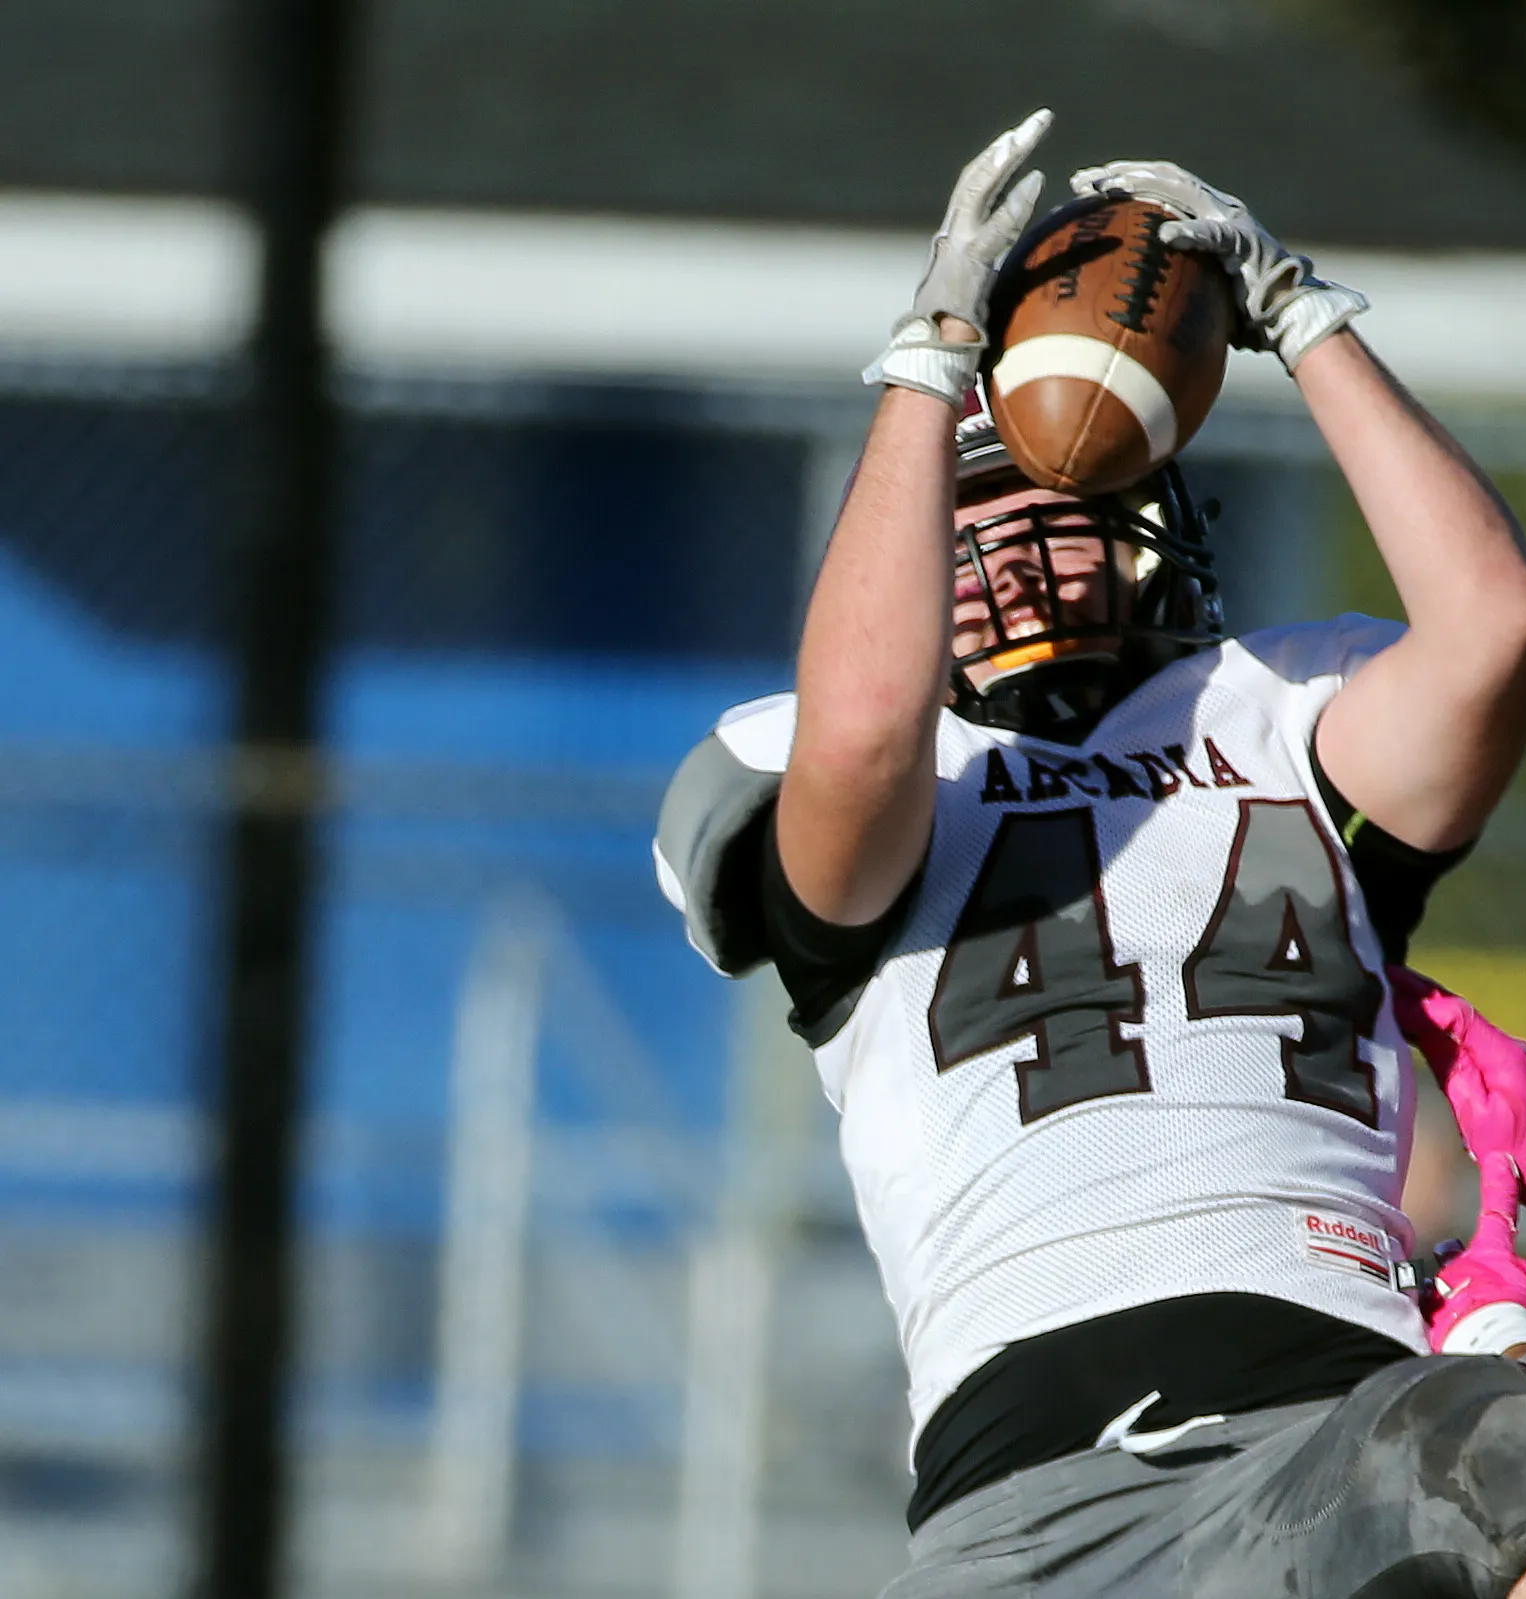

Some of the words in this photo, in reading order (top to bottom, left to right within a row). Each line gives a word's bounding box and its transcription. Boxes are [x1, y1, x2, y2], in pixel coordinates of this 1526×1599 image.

[979, 737, 1254, 804] ARCADIA
[929, 797, 1385, 1130] 44
[1306, 1215, 1380, 1252] Riddell
